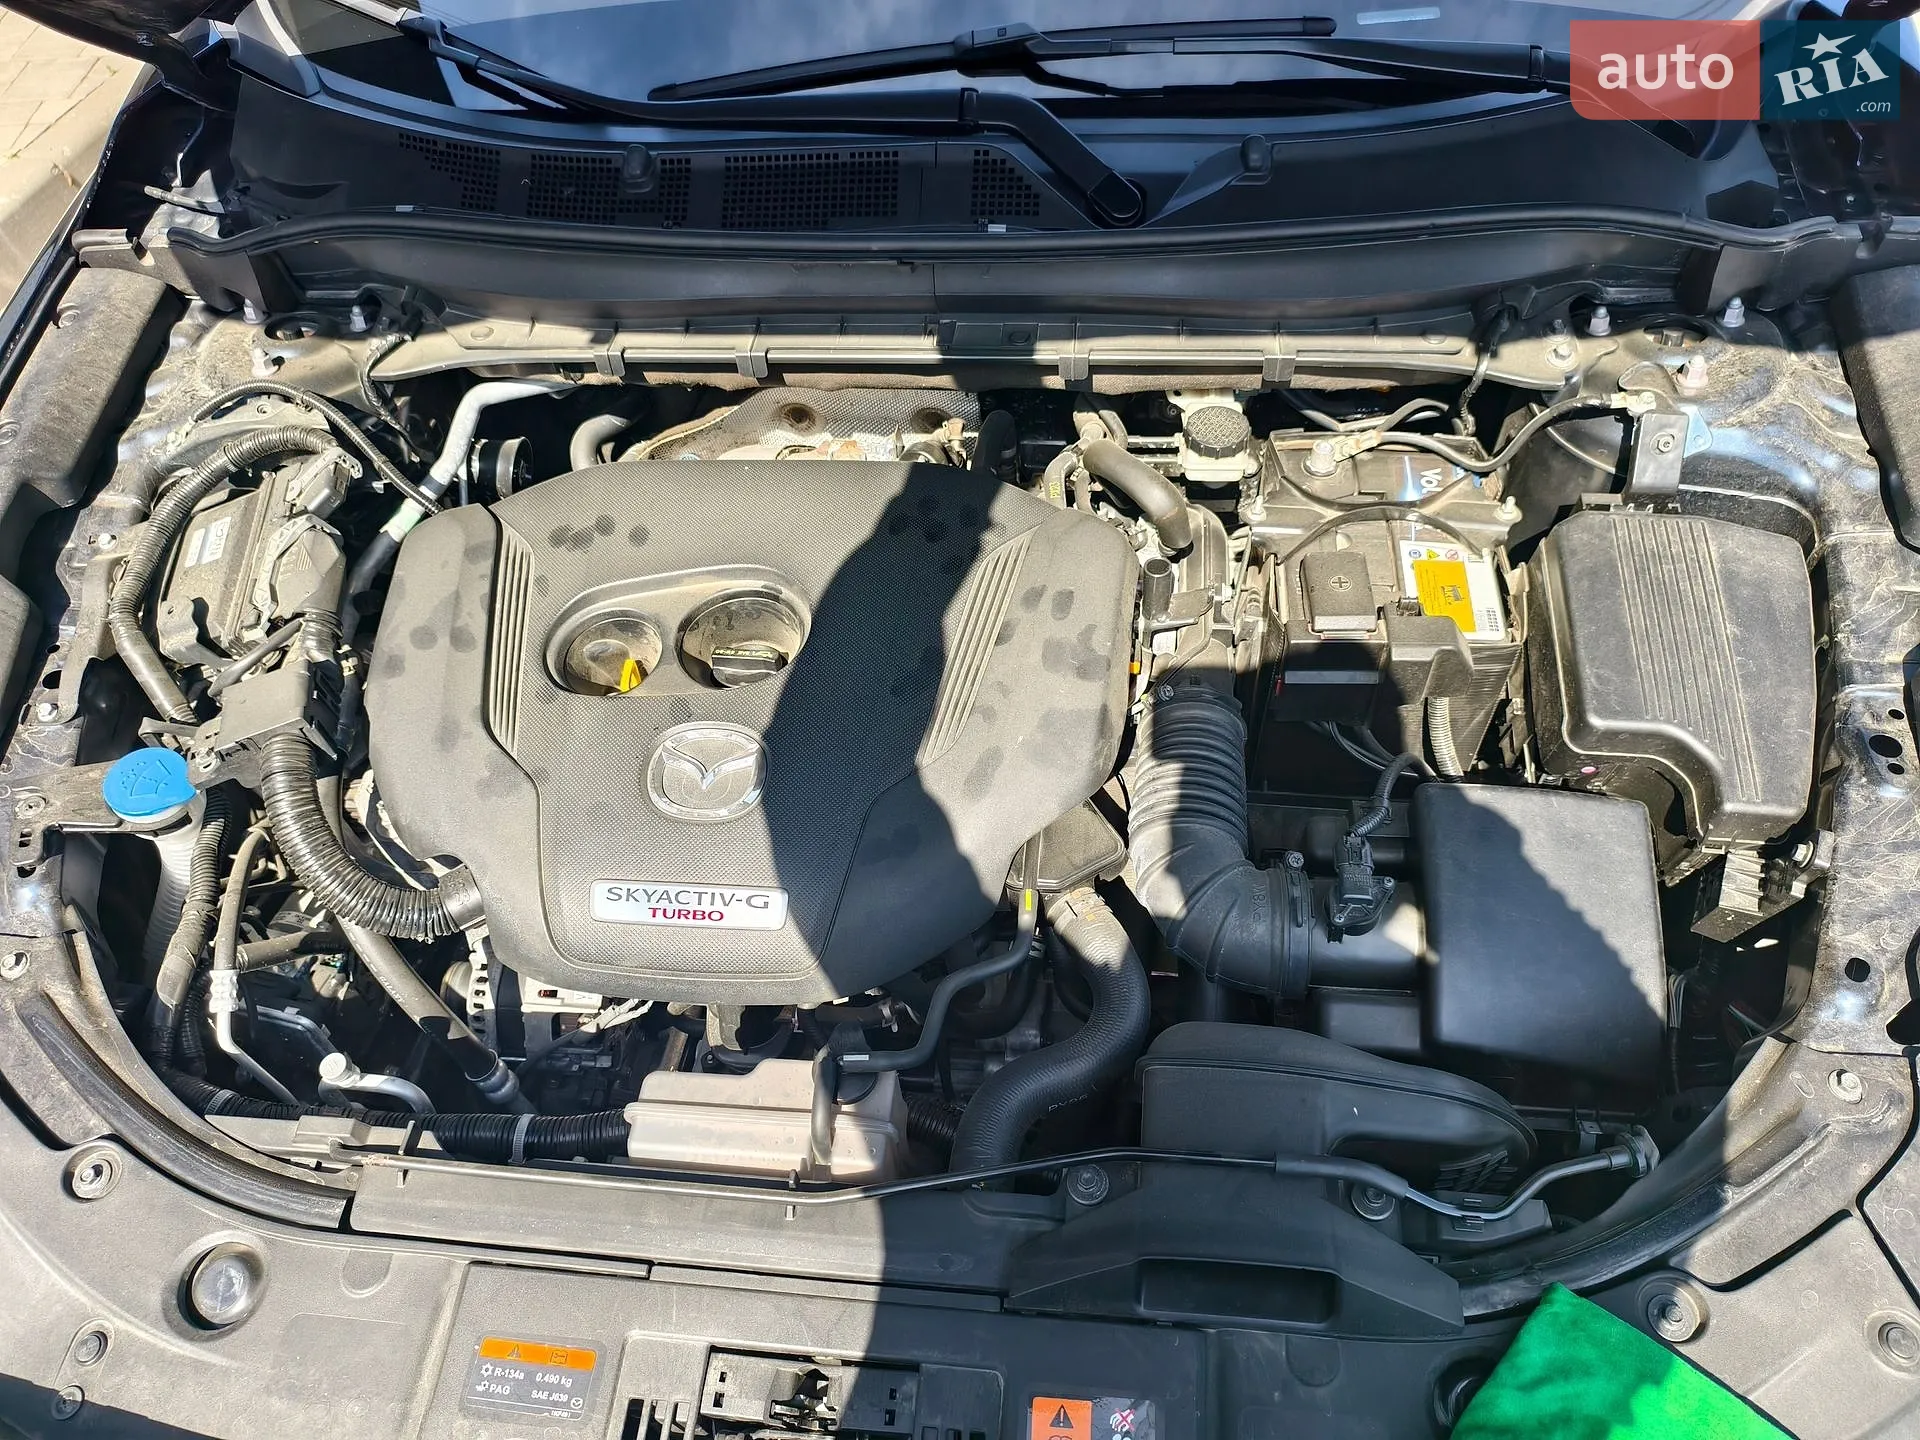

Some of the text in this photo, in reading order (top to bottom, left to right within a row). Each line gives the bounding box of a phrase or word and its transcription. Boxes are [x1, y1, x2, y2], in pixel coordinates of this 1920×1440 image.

[605, 886, 770, 909] SKYACTIV-G
[648, 907, 724, 921] TURBO
[493, 1367, 525, 1380] R-134a
[561, 1375, 573, 1388] kg
[489, 1385, 569, 1403] PAG SAE J639
